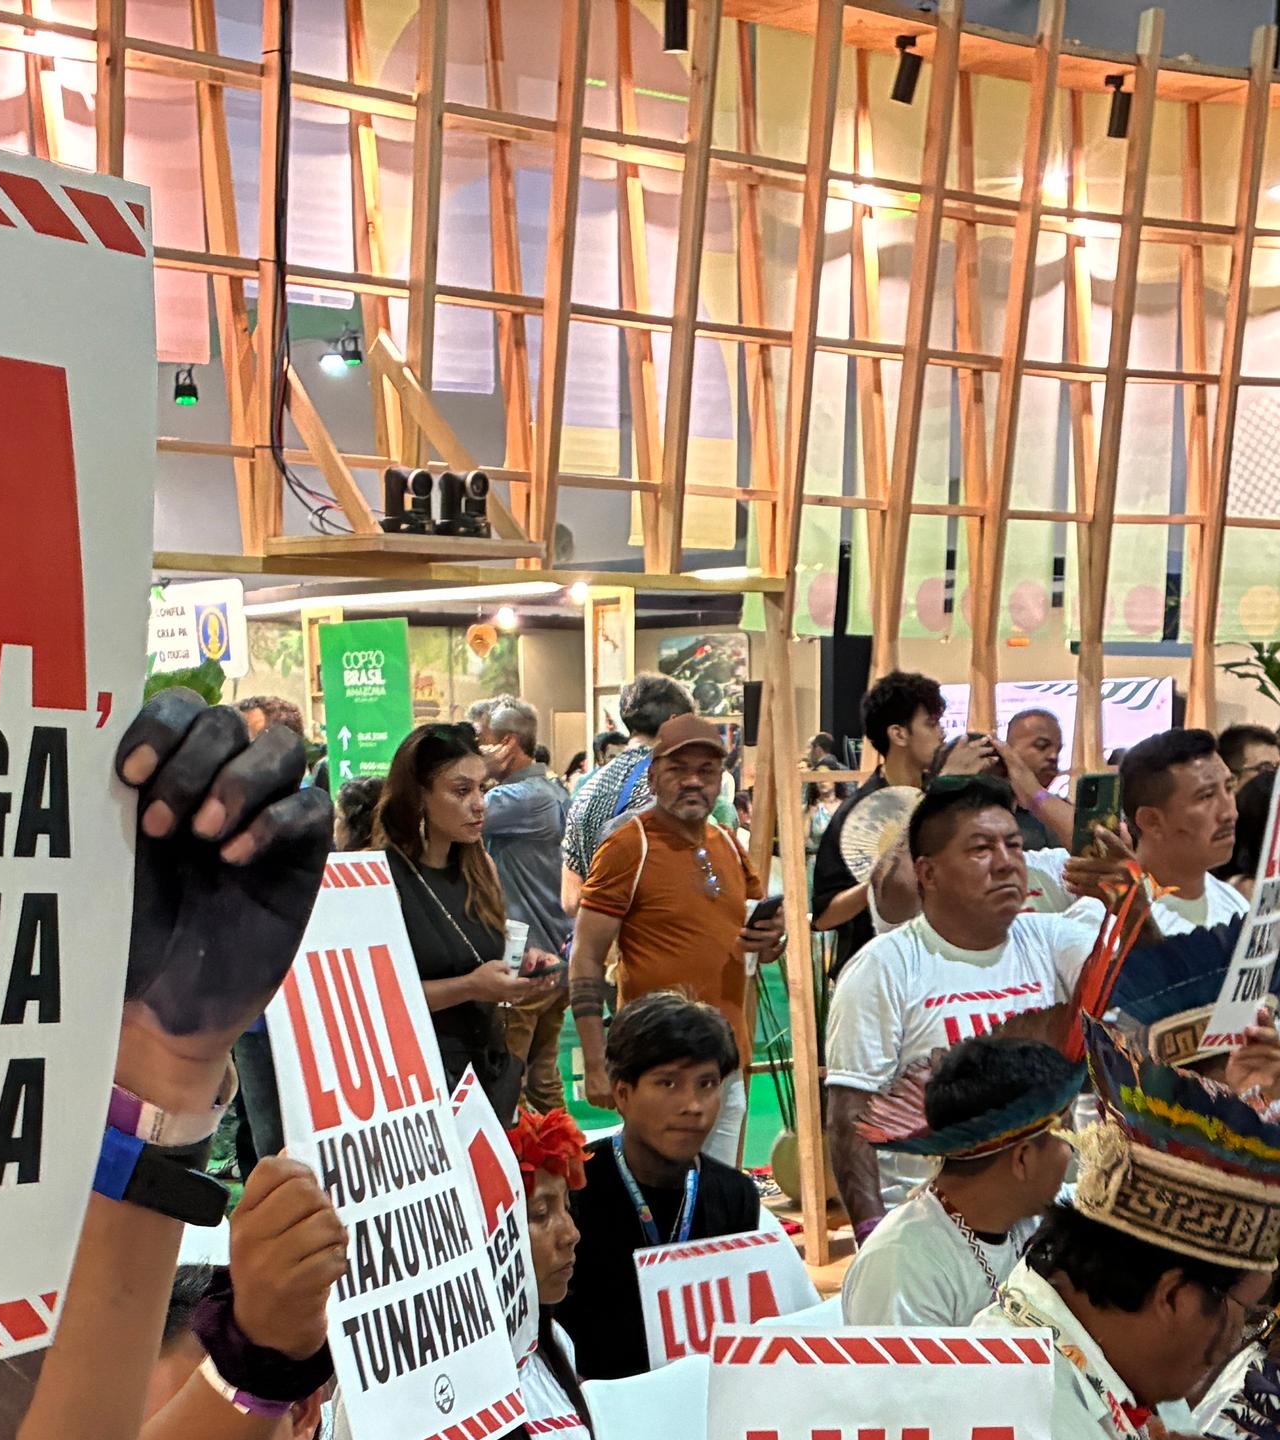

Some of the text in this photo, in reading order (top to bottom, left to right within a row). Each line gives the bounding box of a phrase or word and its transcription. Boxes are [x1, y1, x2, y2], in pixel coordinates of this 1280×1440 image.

[342, 651, 384, 669] COP30
[344, 669, 386, 687] BRASIL
[284, 945, 443, 1132] LULA,
[317, 1109, 453, 1209] HOMOLOGA
[343, 1267, 496, 1392] TUNAYANA
